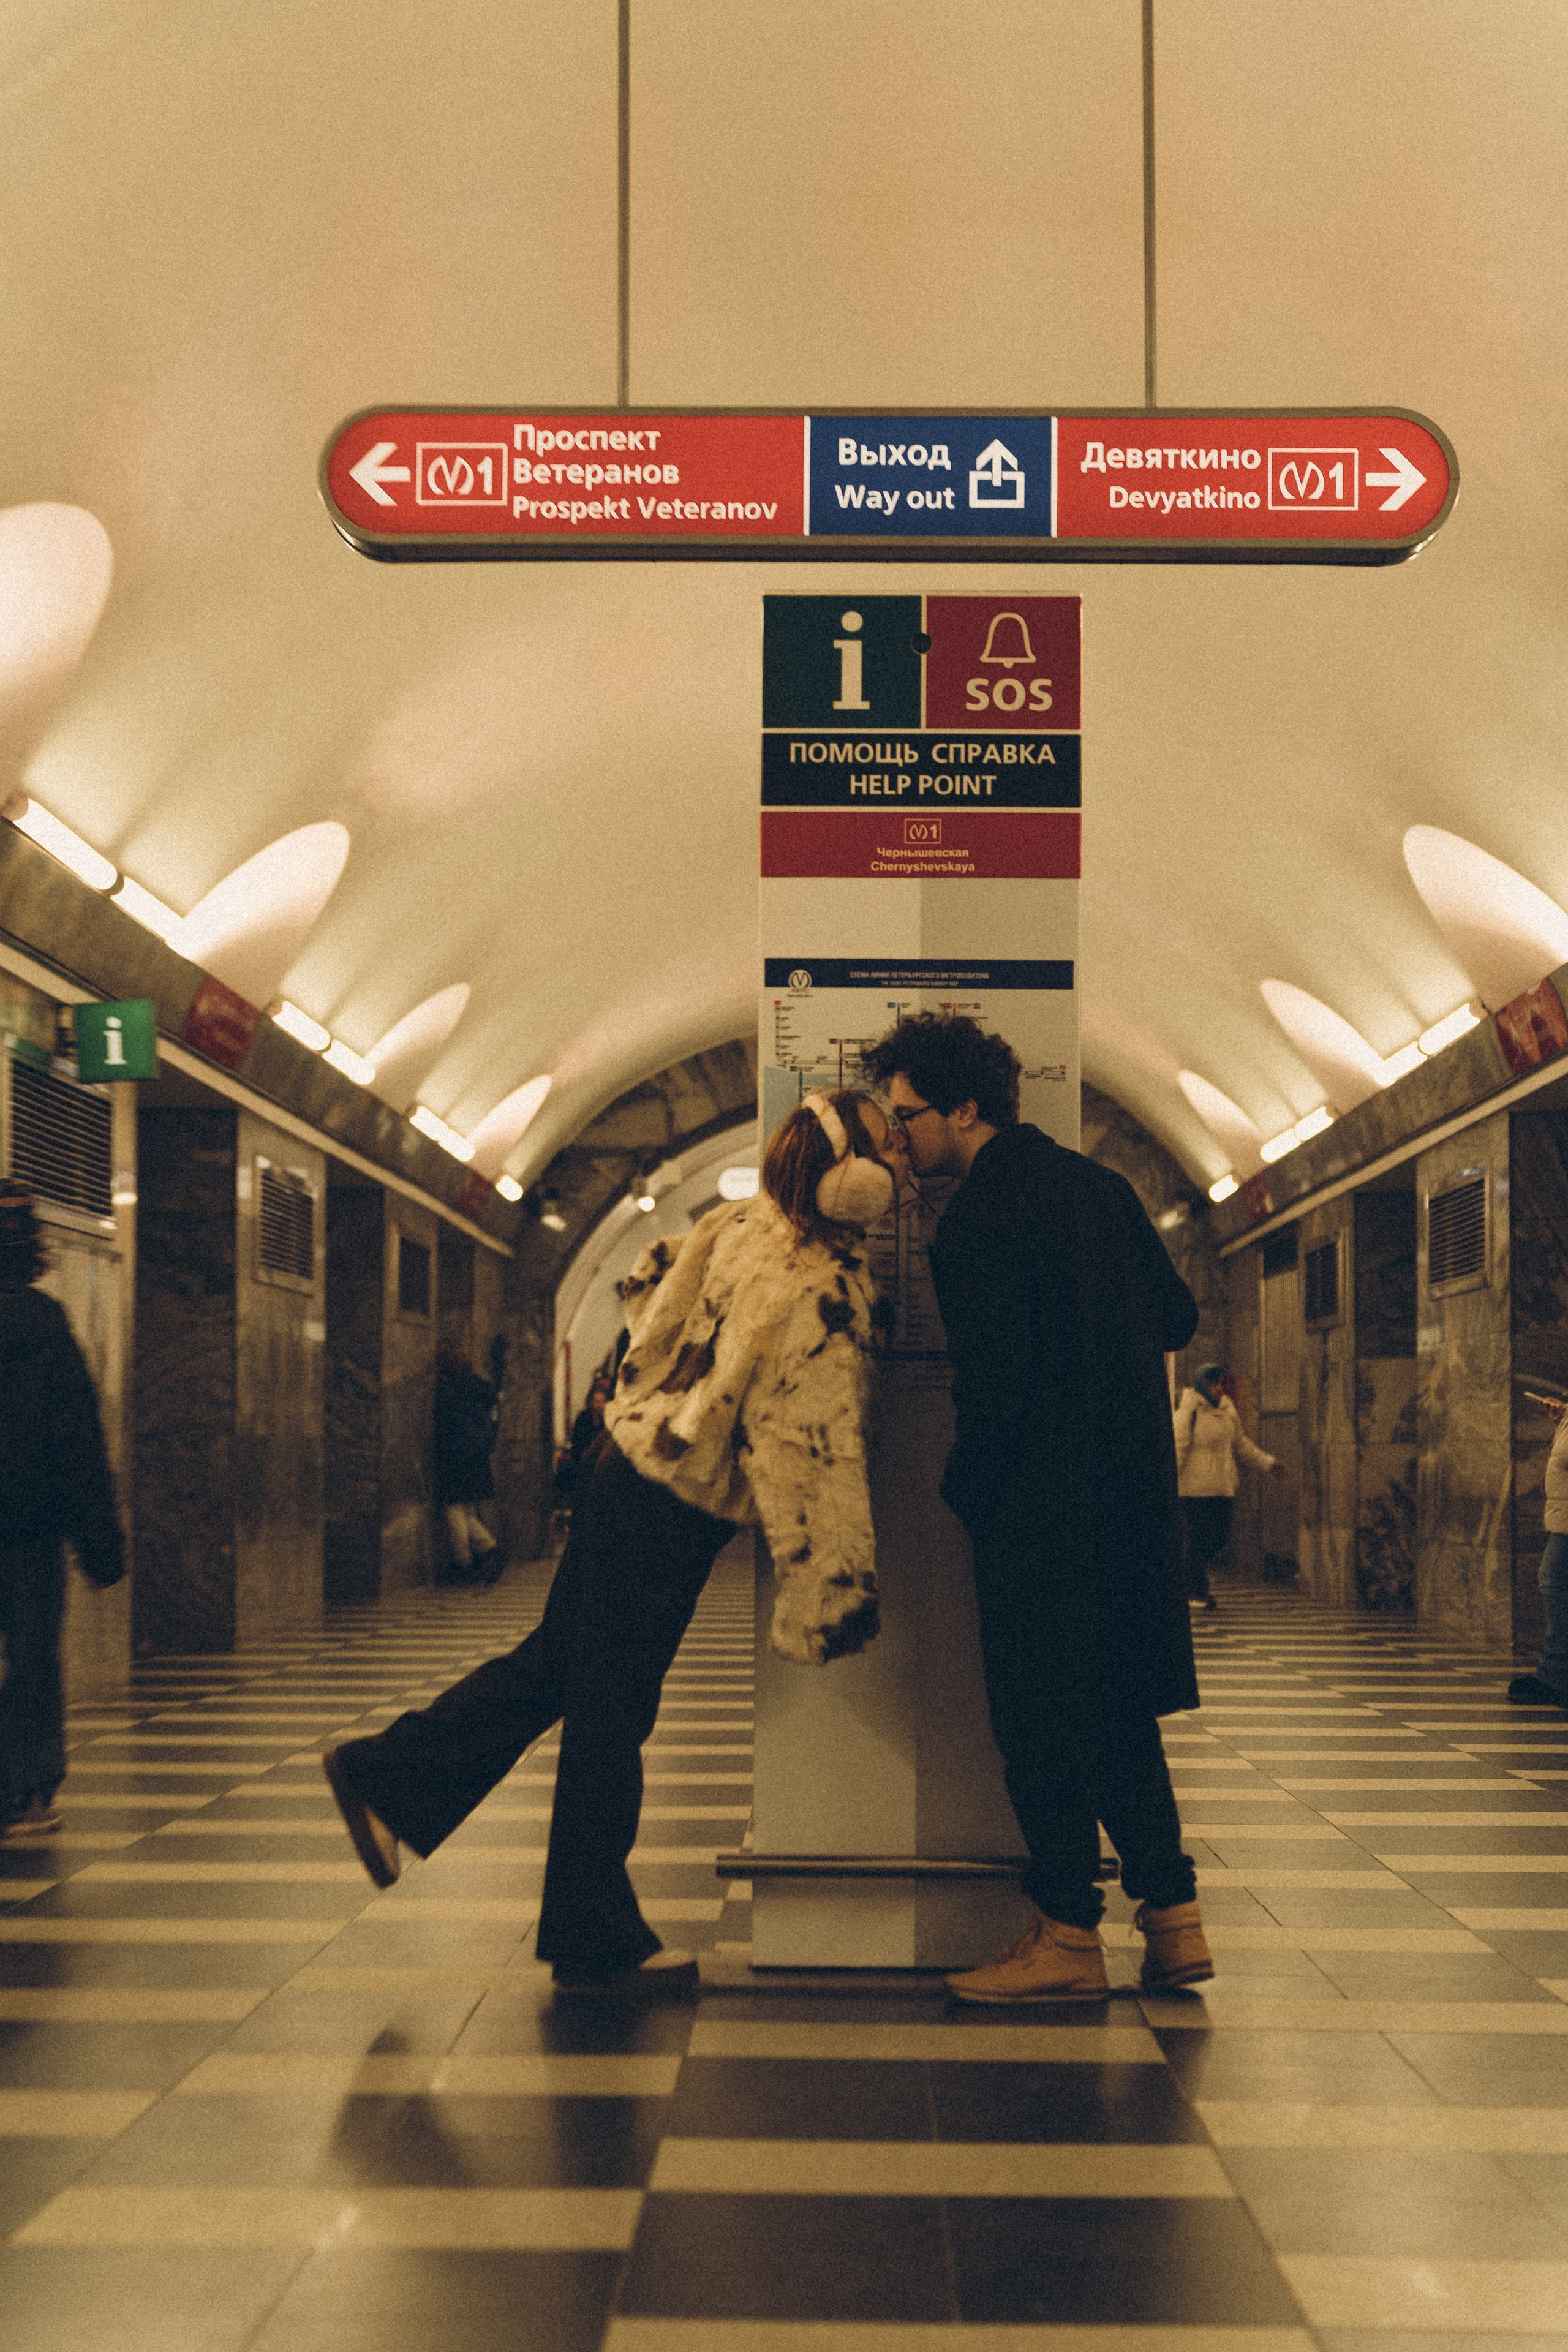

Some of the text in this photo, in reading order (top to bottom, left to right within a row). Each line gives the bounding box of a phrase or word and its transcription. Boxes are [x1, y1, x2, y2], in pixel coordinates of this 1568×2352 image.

[513, 424, 661, 457] Проспект
[838, 437, 951, 470] Выход
[1080, 442, 1261, 473] Девяткино
[513, 458, 680, 491] Ветеранов
[513, 495, 778, 524] Prospekt Veteranov
[834, 484, 955, 515] Way out
[1109, 485, 1261, 514] Devyatkino
[965, 677, 1053, 712] SOS
[790, 742, 1057, 767] ПОМОЩЬ СПРАВКА
[850, 774, 997, 796] HELP POINT
[870, 861, 976, 874] Chernyshevskaya
[876, 846, 969, 859] Чернышевская
